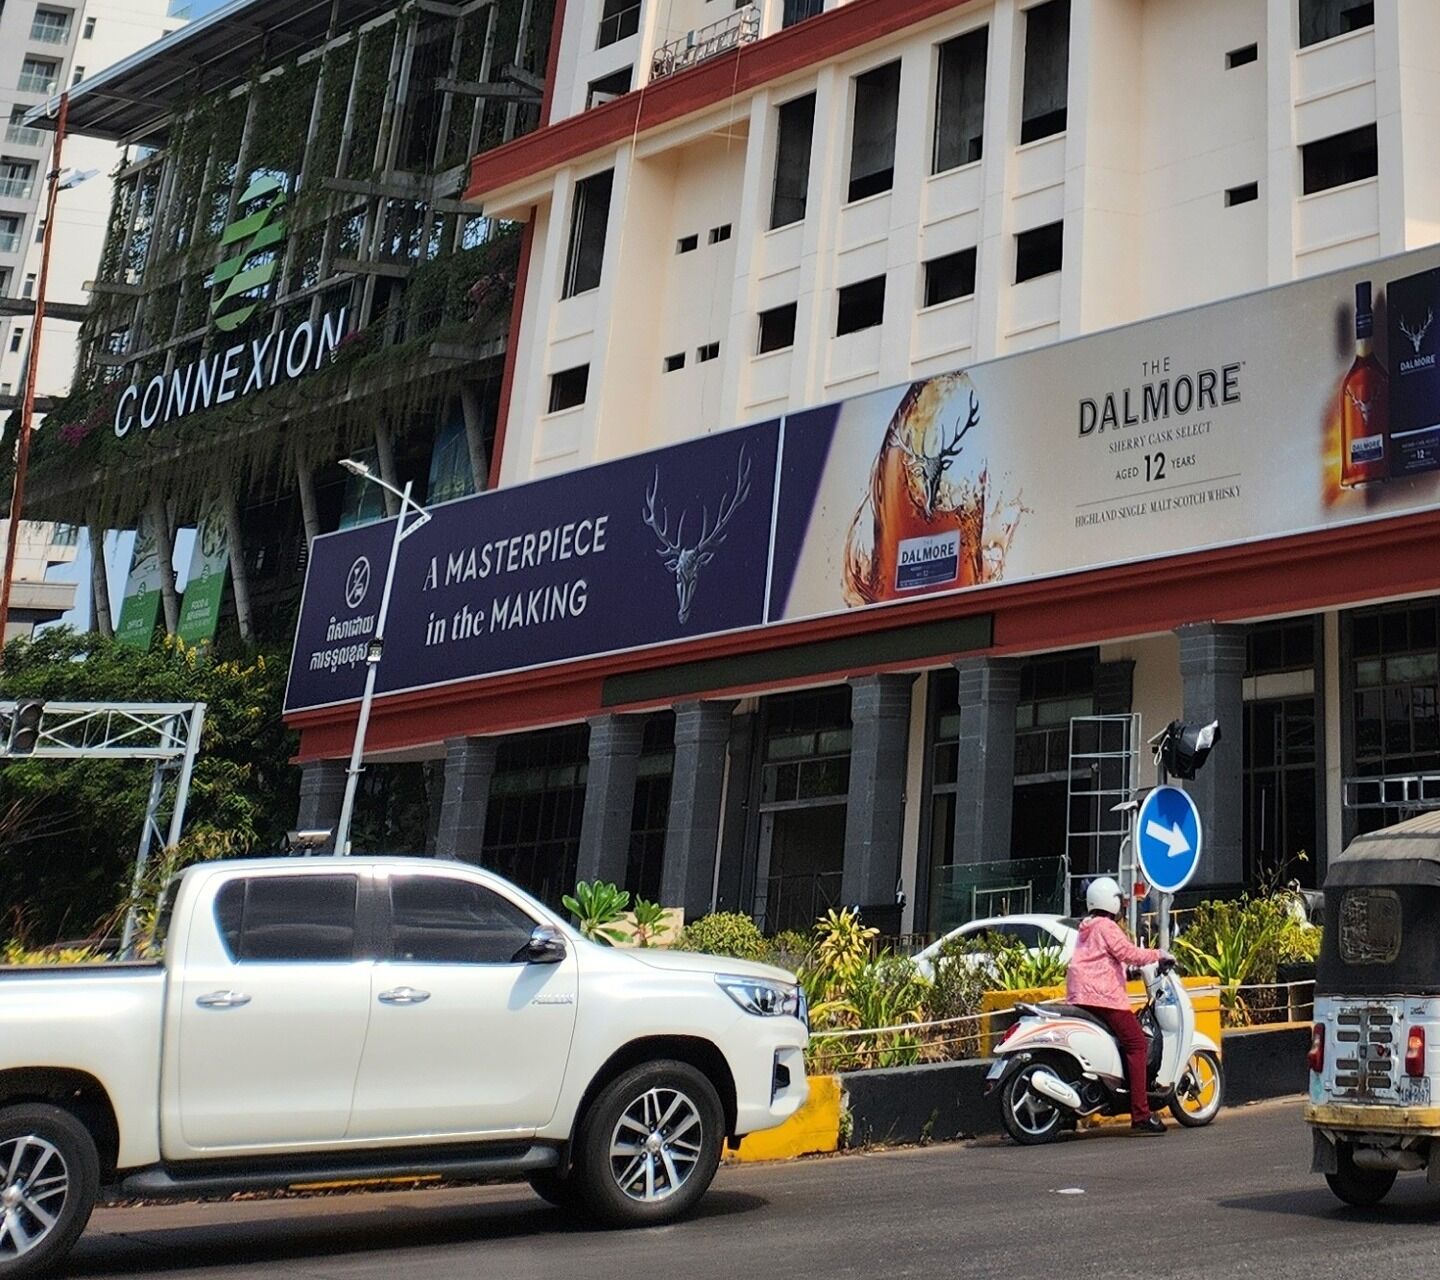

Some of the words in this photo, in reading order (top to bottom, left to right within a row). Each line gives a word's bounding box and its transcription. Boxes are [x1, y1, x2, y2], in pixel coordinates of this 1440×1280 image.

[114, 306, 346, 438] CONNEXION
[1142, 356, 1171, 377] THE
[1400, 353, 1436, 371] DALMORE
[1078, 361, 1242, 438] DALMORE
[1109, 434, 1147, 454] SHERRY
[1149, 429, 1173, 446] CASK
[1176, 420, 1213, 440] SELECT
[1116, 466, 1139, 480] AGED
[1144, 451, 1166, 482] 12
[1171, 454, 1196, 470] YEARS
[1075, 508, 1117, 528] HIGHLAND
[1118, 503, 1147, 520] SINGLE
[1150, 497, 1175, 513] MALT
[1173, 489, 1207, 509] SCOTCH
[1207, 484, 1242, 502] WHISKY
[422, 556, 439, 592] A
[445, 515, 609, 586] MASTERPIECE
[901, 541, 956, 564] DALMORE
[425, 611, 447, 646] in
[450, 604, 485, 641] the
[489, 578, 589, 633] MAKING
